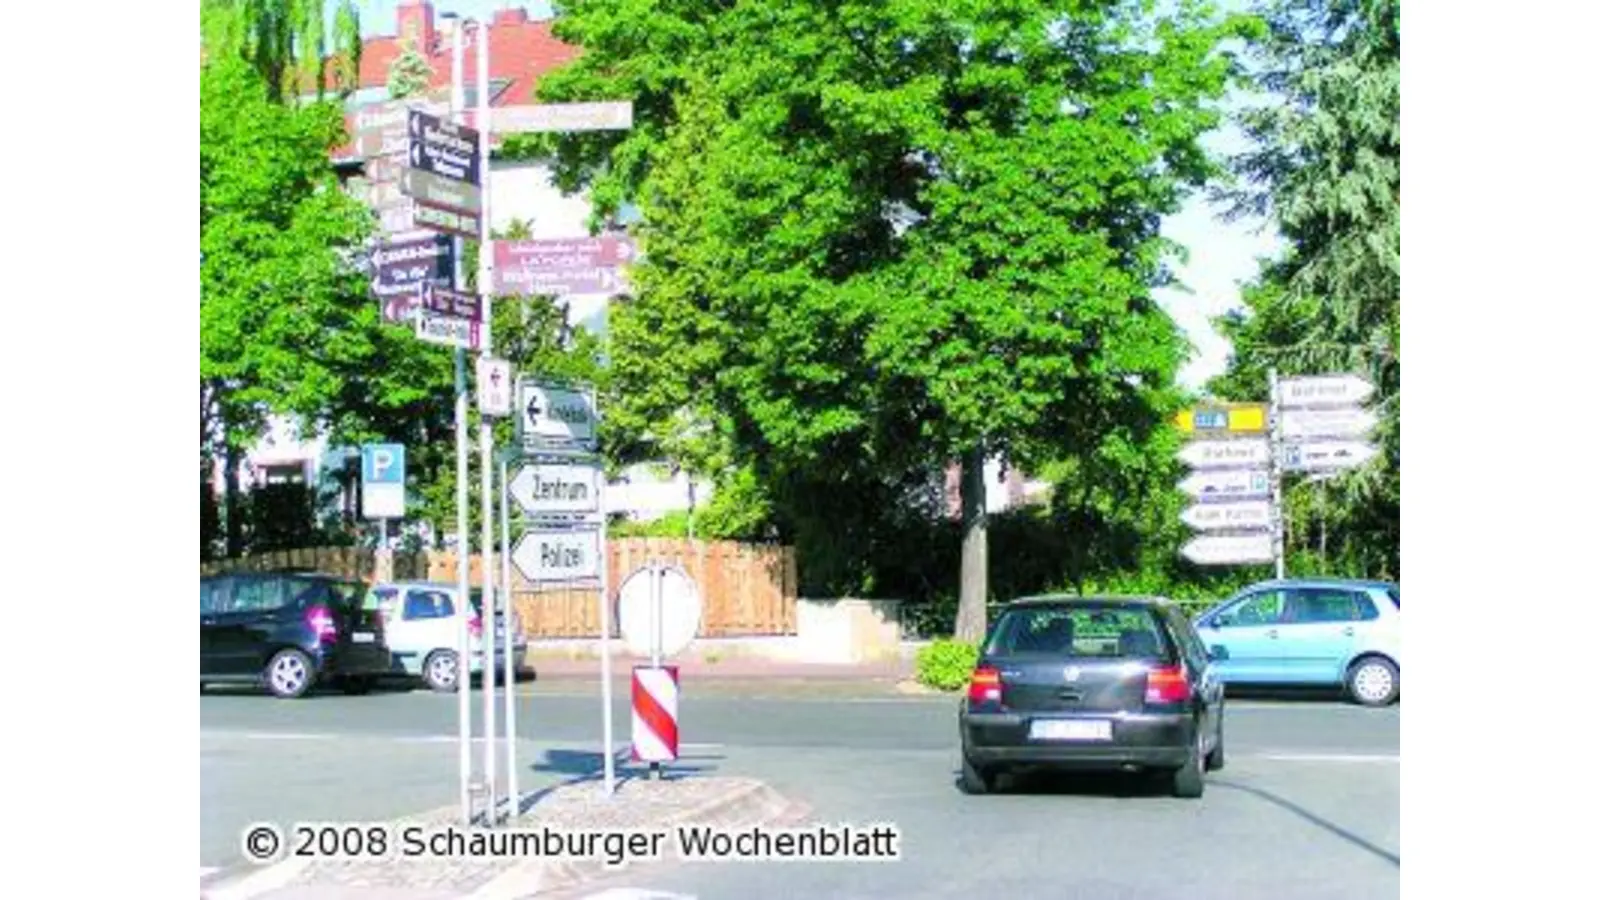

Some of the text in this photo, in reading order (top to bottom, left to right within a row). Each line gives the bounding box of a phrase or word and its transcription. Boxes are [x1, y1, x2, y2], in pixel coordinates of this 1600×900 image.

[373, 449, 393, 480] P
[532, 474, 588, 501] Zentrum
[540, 541, 585, 568] Polizei
